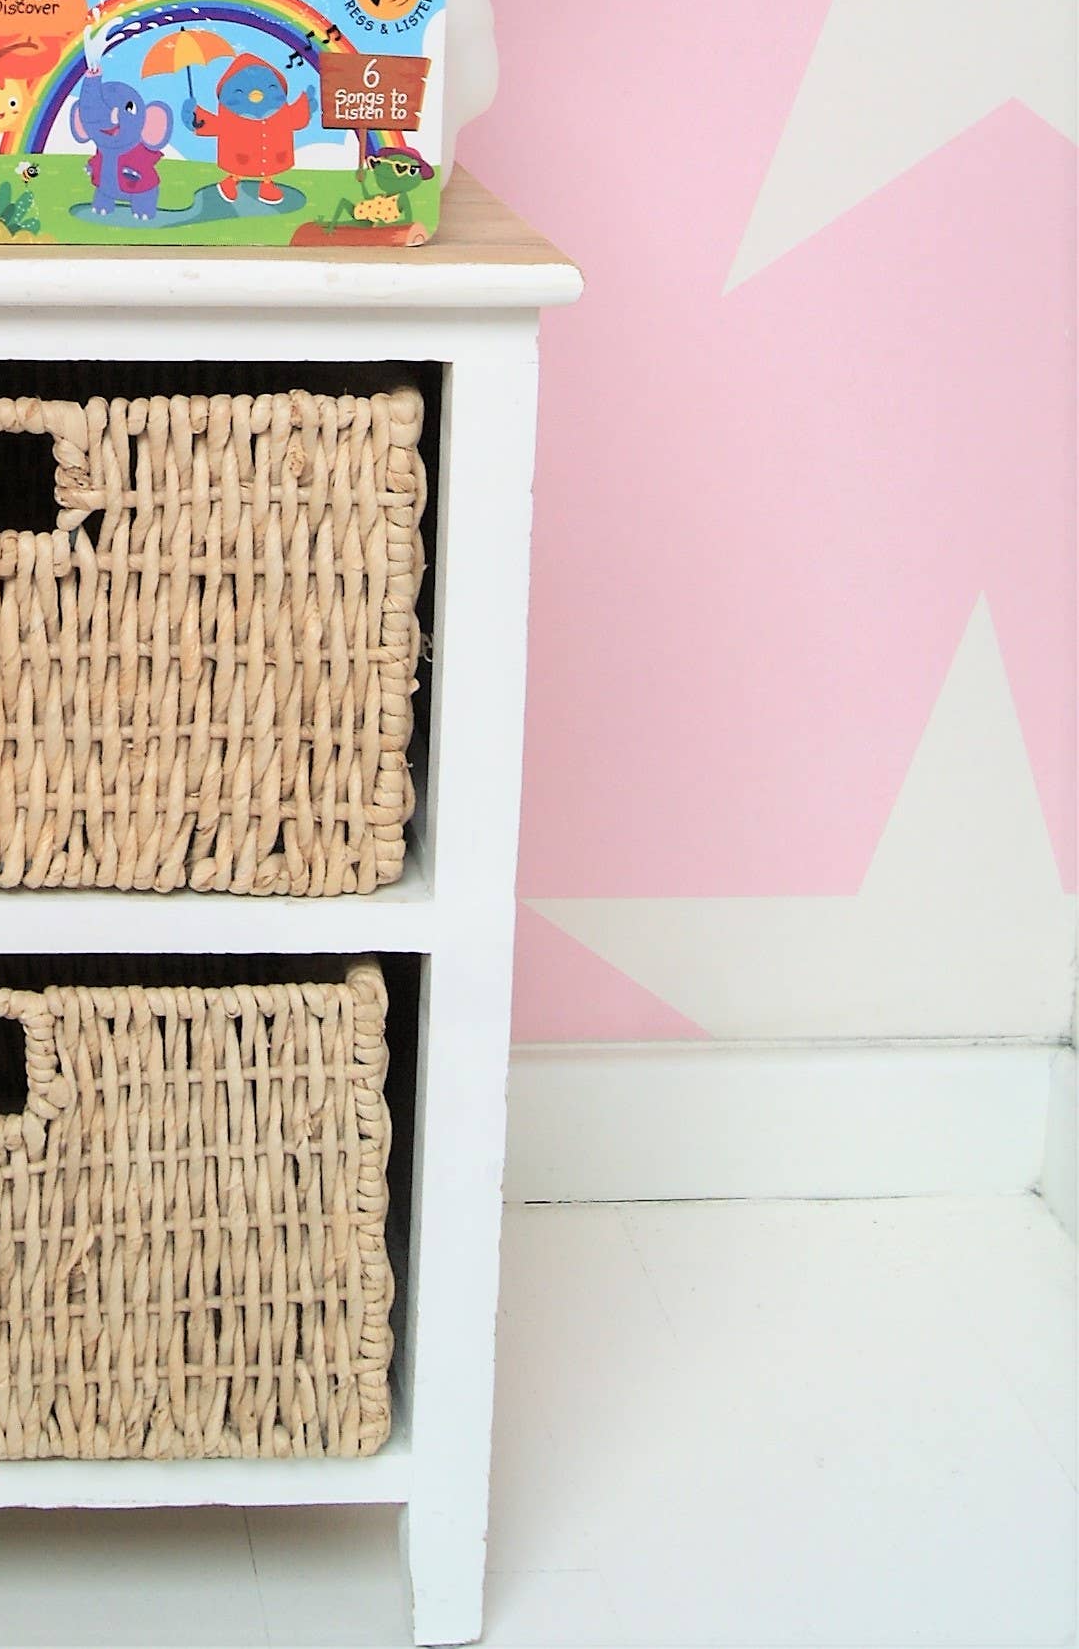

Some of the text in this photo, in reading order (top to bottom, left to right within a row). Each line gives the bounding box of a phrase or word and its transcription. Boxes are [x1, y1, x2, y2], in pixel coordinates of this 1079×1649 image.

[380, 23, 390, 35] &
[362, 58, 380, 89] 6
[335, 88, 408, 110] Songs to
[335, 102, 408, 120] Listen to
